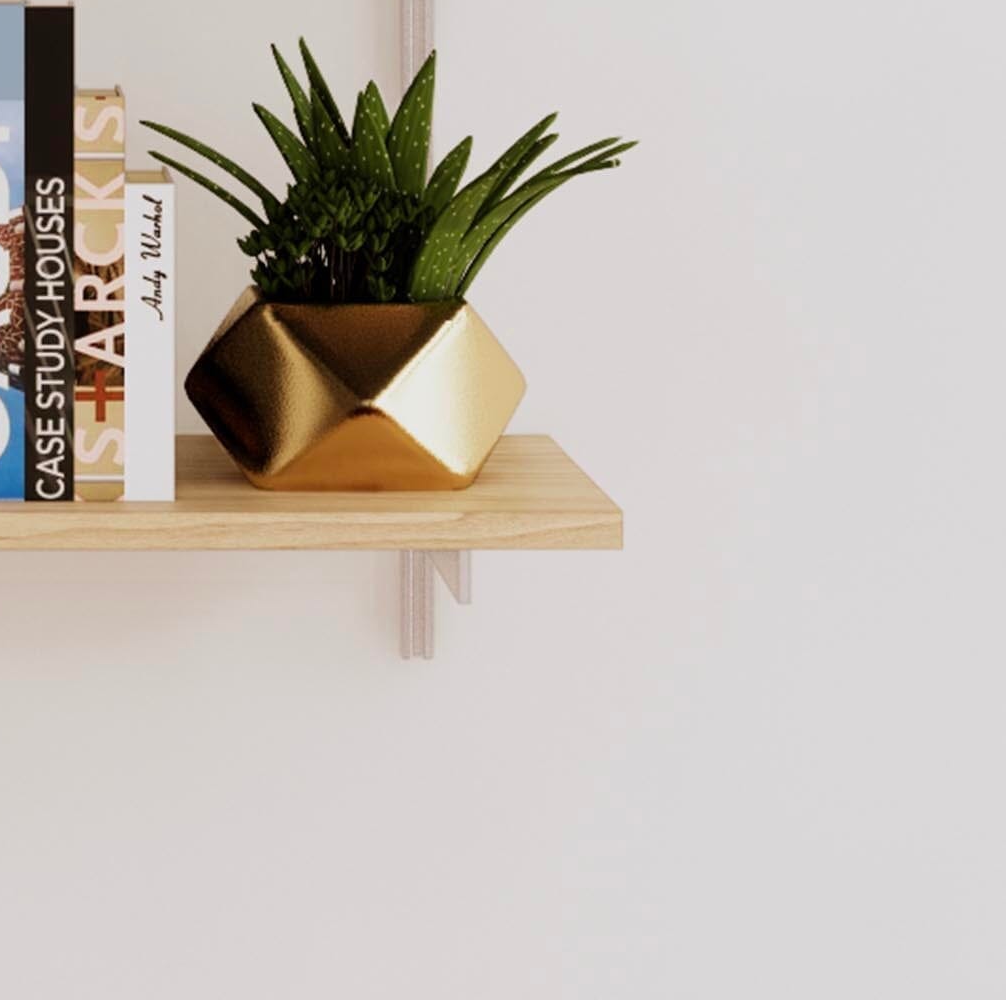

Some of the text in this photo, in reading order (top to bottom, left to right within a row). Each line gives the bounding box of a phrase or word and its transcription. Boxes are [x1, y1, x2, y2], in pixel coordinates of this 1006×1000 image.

[36, 176, 65, 499] CASE STUDY HOUSES
[140, 194, 168, 321] Andy Warhol
